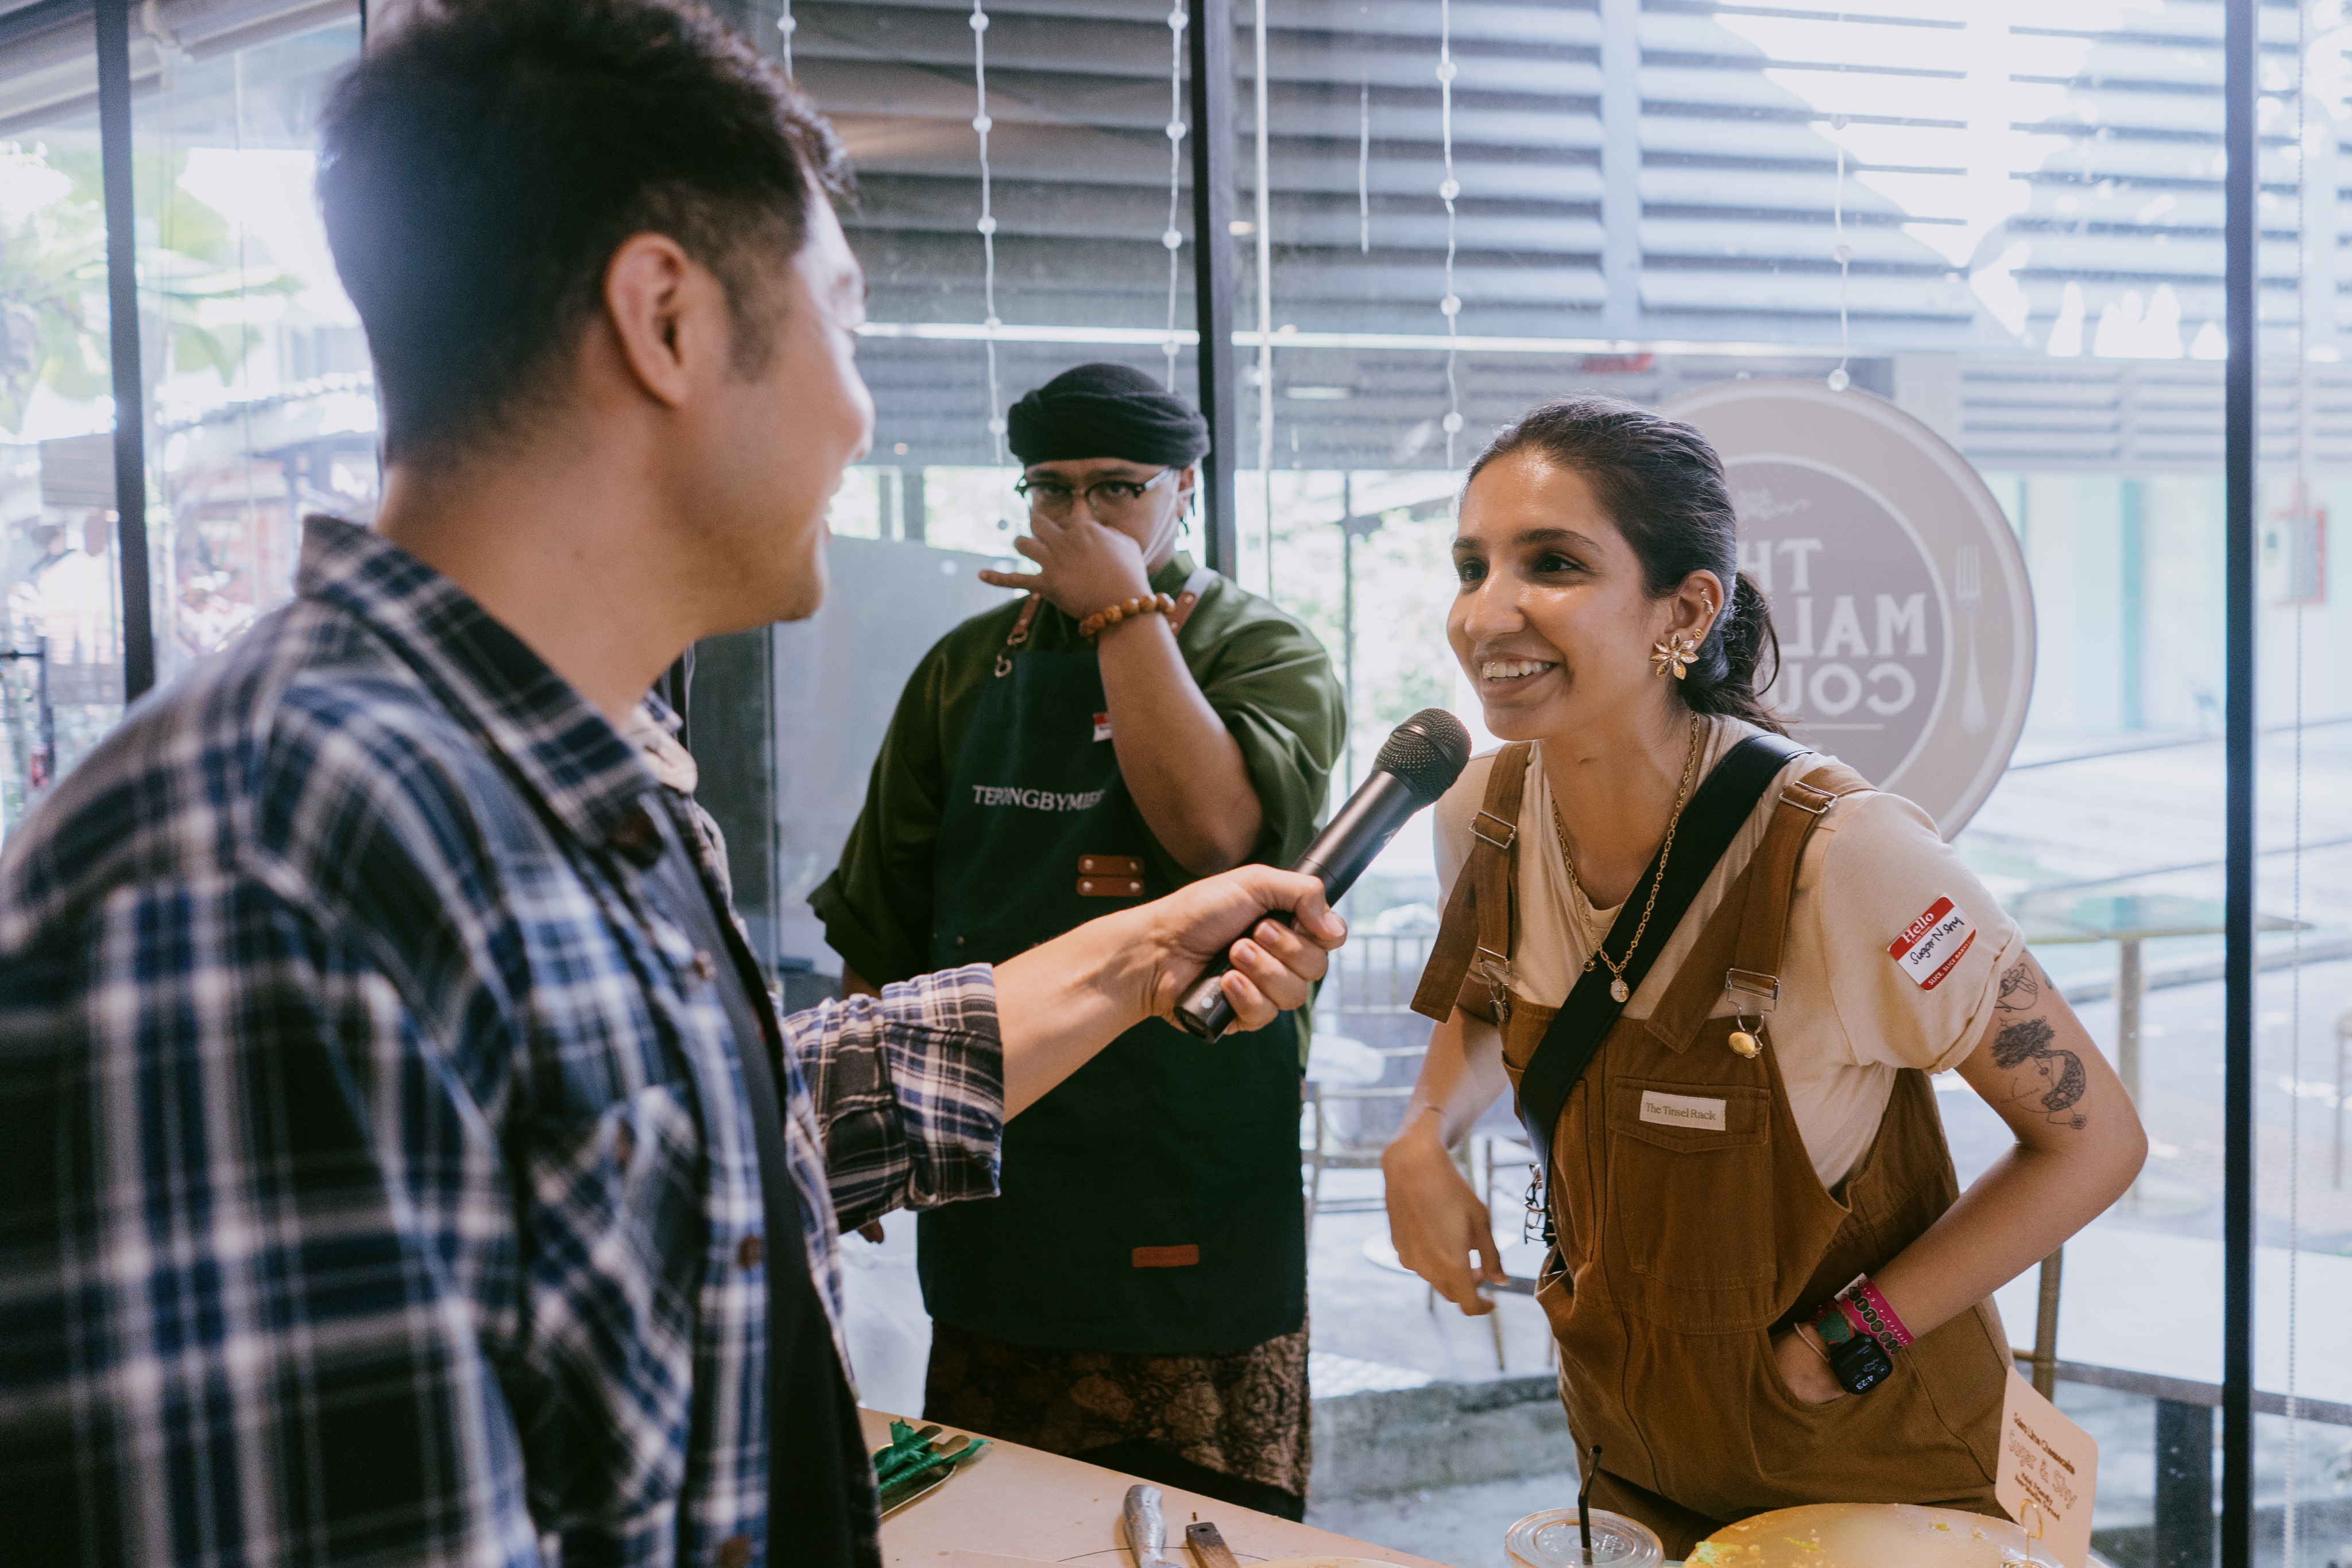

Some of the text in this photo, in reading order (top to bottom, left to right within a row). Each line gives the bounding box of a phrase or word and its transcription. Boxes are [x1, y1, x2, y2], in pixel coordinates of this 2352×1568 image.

[1901, 912, 1935, 943] Hello
[1910, 938, 1935, 965] Sugar
[1931, 927, 1944, 942] N
[1914, 934, 1922, 943] am
[1942, 958, 1957, 971] SLICE
[1645, 1102, 1716, 1120] The Tinsel Rack
[1855, 1375, 1874, 1390] 4:23
